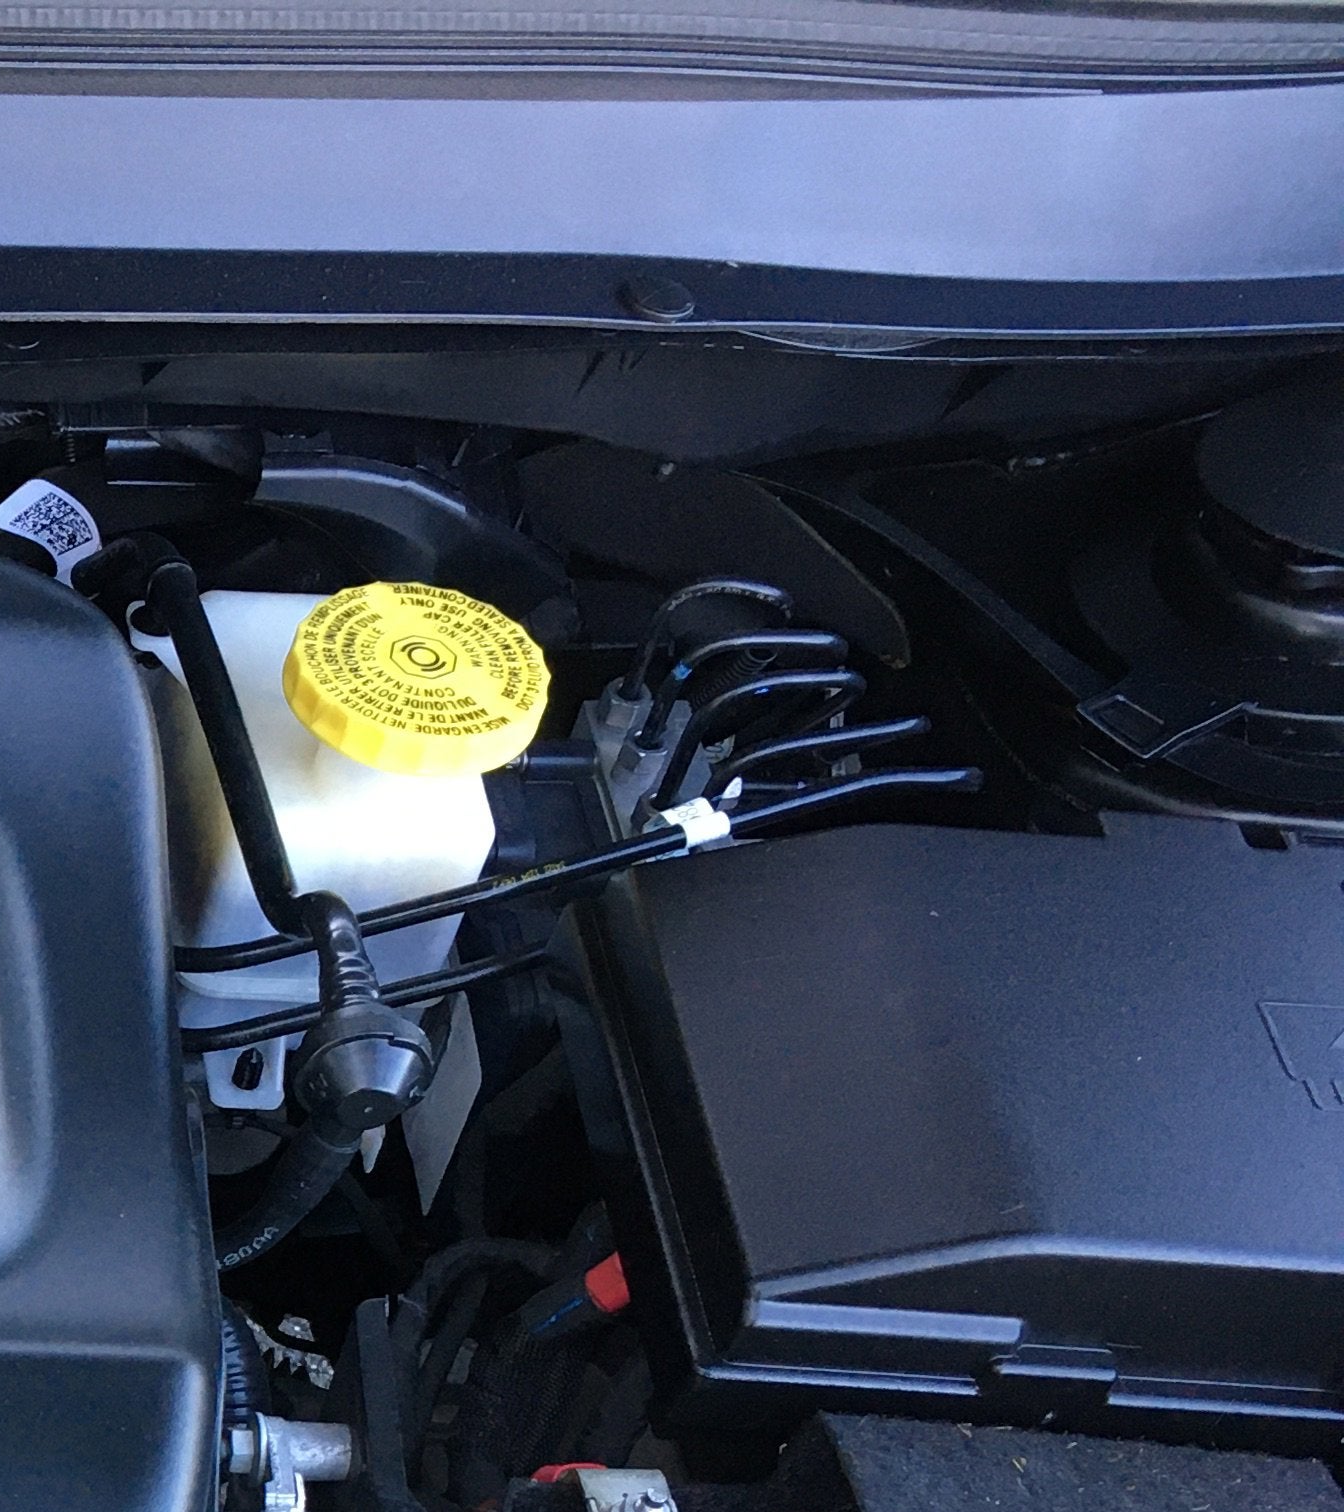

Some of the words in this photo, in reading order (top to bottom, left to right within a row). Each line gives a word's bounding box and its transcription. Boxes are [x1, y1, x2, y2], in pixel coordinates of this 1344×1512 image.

[308, 588, 369, 628] REMPLISSAGE
[400, 597, 435, 608] ONLY
[440, 603, 467, 618] USE
[467, 601, 511, 629] SEALED
[323, 602, 371, 645] UNIQUEMENT
[423, 611, 451, 624] CAP
[304, 629, 319, 640] DE
[453, 621, 490, 648] FILLER
[472, 617, 518, 662] REMOVING
[341, 625, 367, 679] PROVENANT
[513, 635, 537, 662] FROM
[304, 643, 333, 685] BOUCHON
[322, 647, 352, 685] UTILISER
[485, 650, 504, 679] CLEAN
[526, 662, 542, 686] FLUID
[326, 686, 344, 697] LE
[367, 666, 455, 698] CONTENANT
[370, 686, 398, 702] DOT
[501, 666, 522, 699] BEFORE
[340, 696, 407, 729] NETTOYER
[349, 686, 403, 716] RETIRER
[401, 697, 457, 711] LIQUIDE
[456, 696, 477, 708] DU
[407, 711, 424, 720] LE
[429, 714, 446, 723] DE
[450, 708, 489, 723] AVANT
[482, 716, 511, 731] MISE
[462, 724, 483, 734] EN
